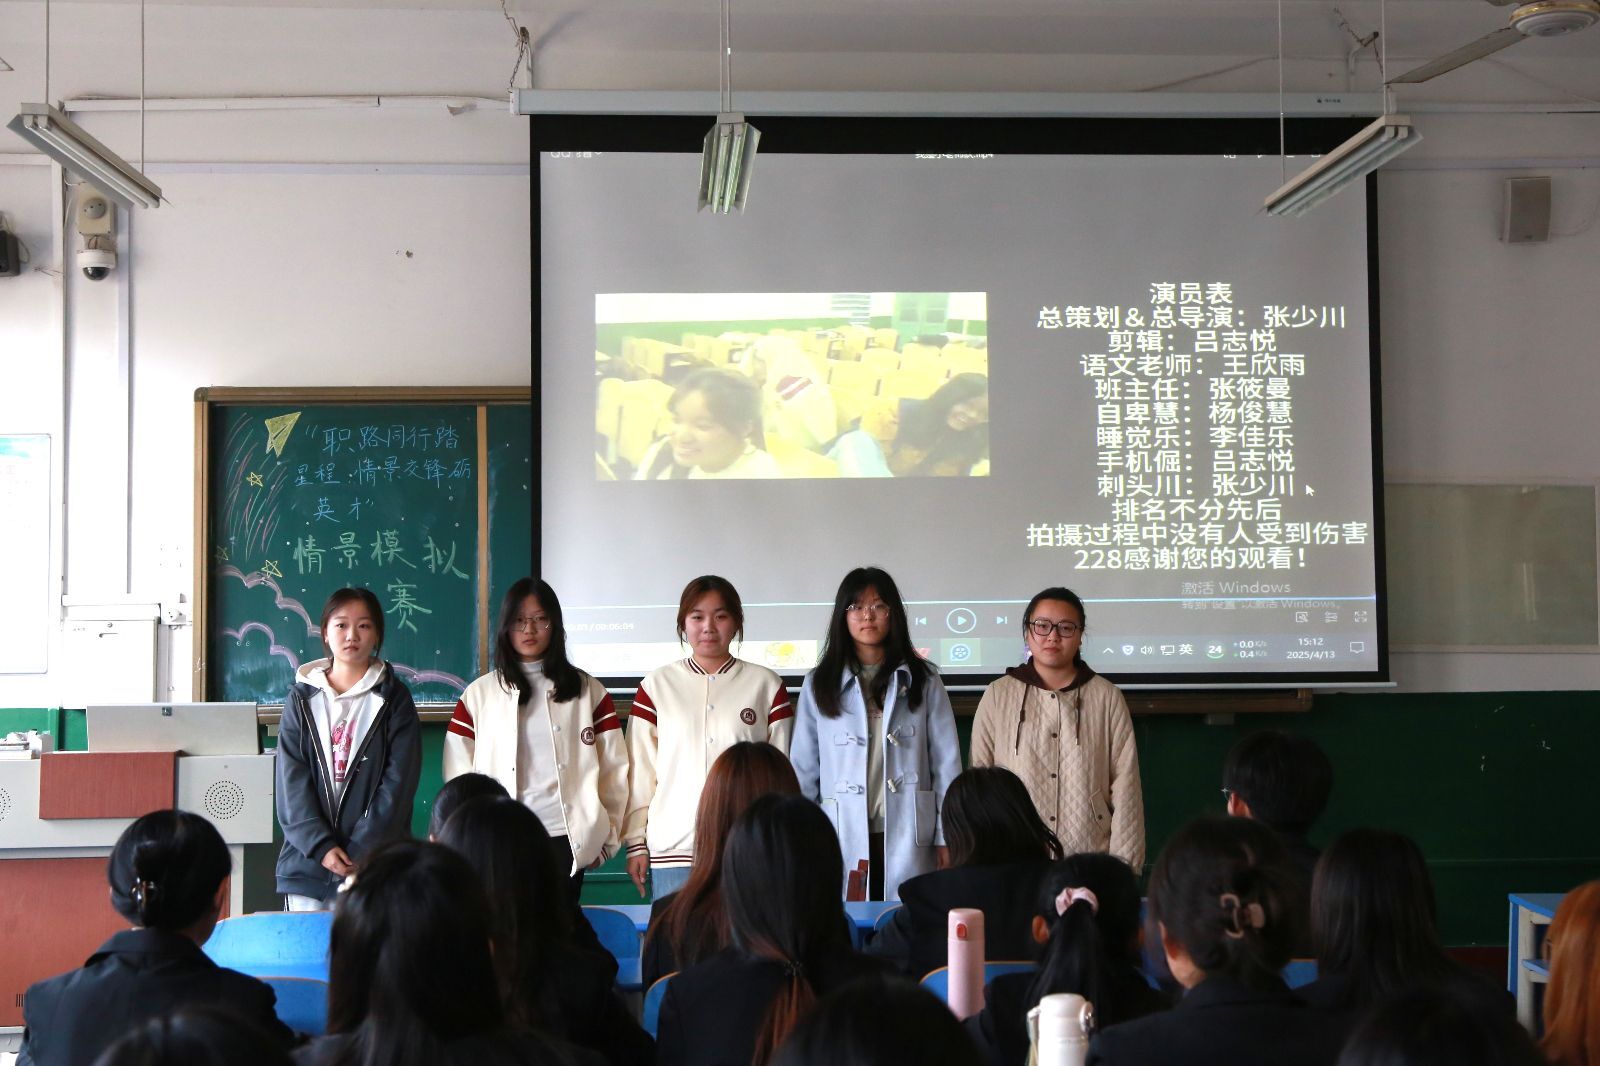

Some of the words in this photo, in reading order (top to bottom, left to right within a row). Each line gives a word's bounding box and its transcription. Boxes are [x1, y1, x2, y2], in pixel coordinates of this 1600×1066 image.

[1149, 282, 1233, 305] 演员表
[1111, 498, 1282, 522] 排名不分先后
[1026, 522, 1368, 547] 拍摄过程中没有人受到伤害
[292, 530, 470, 580] 情景模拟
[1074, 547, 1305, 570] 228感谢您的观看！
[1182, 581, 1214, 595] 激活
[1219, 581, 1291, 593] Windows
[1179, 644, 1193, 655] 英
[1208, 645, 1222, 654] 24
[1298, 638, 1324, 646] 15:12
[1286, 651, 1335, 659] 2025/4/13
